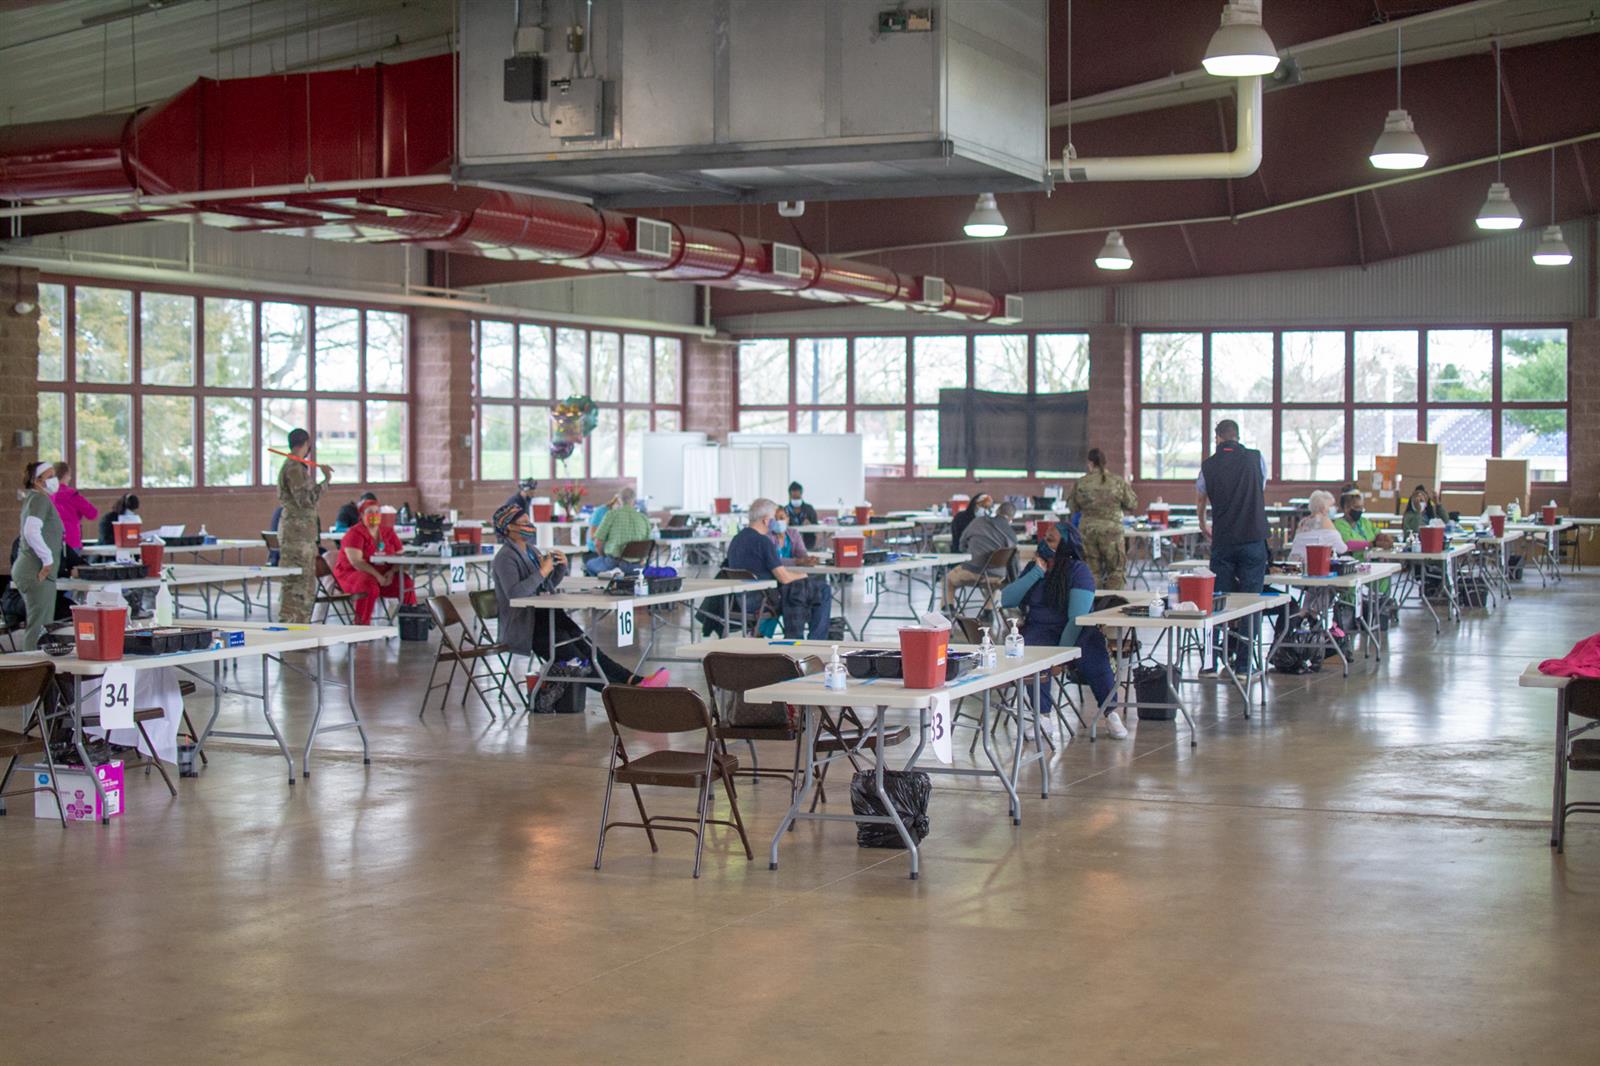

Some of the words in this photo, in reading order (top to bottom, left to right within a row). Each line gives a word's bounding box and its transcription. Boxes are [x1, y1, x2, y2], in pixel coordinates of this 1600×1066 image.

[452, 566, 465, 583] 22
[619, 611, 632, 636] 16
[105, 683, 129, 708] 34
